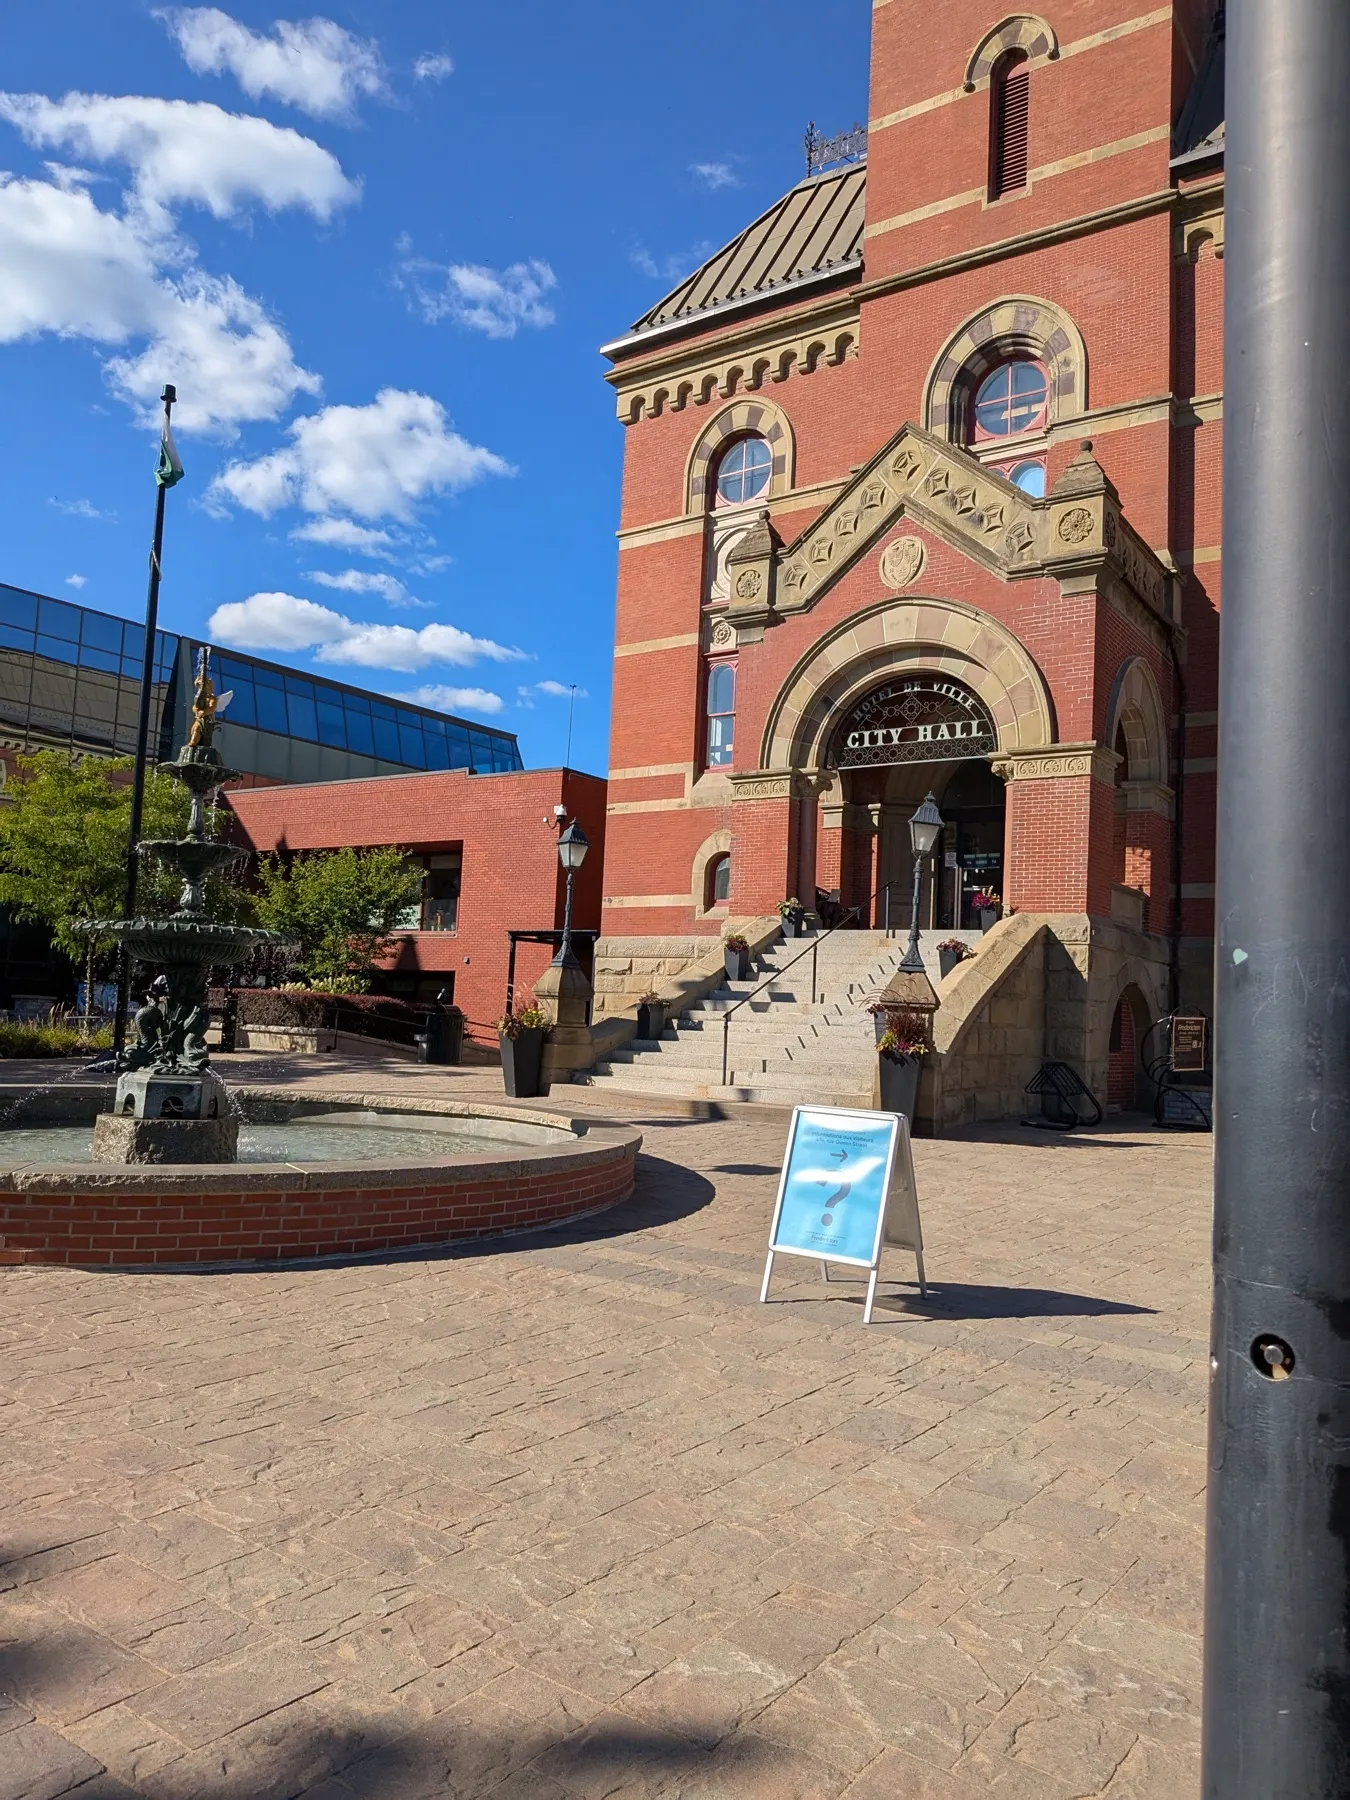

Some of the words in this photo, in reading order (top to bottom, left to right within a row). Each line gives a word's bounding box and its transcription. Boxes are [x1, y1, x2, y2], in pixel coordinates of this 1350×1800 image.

[852, 688, 894, 721] HOTEL
[903, 681, 922, 692] DE
[933, 683, 976, 710] VILLE
[847, 729, 903, 748] CITY
[918, 720, 984, 742] HALL
